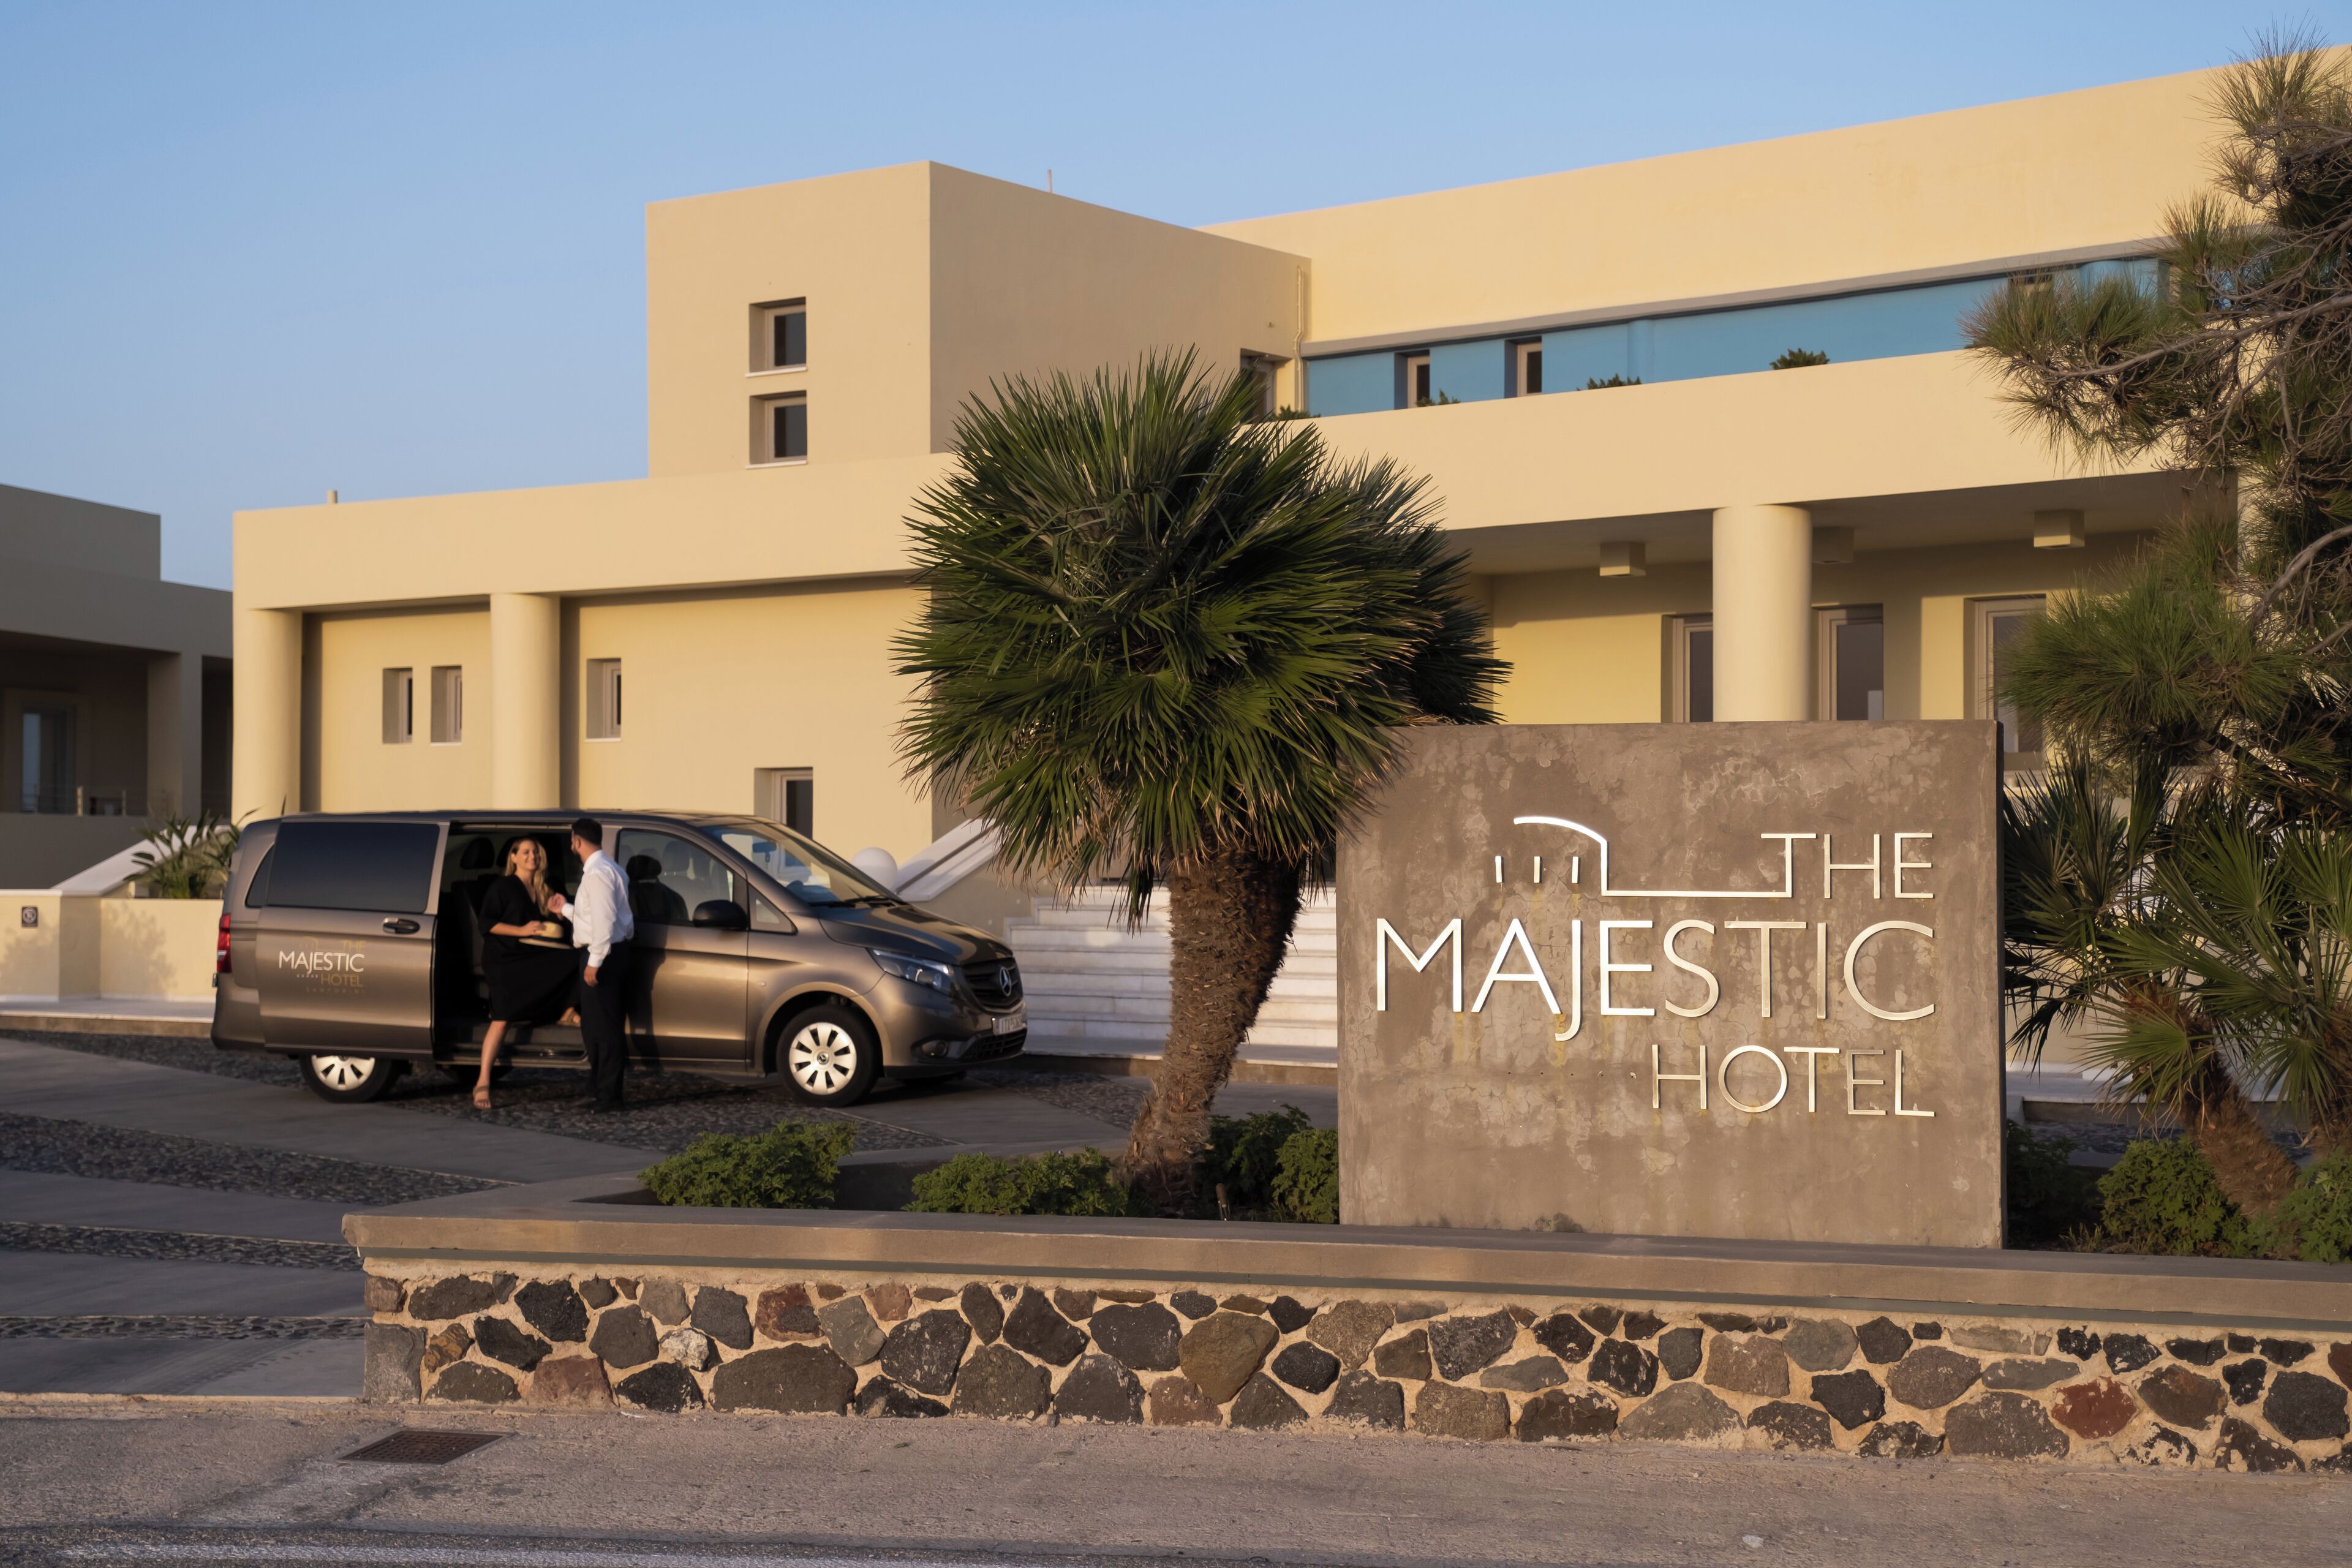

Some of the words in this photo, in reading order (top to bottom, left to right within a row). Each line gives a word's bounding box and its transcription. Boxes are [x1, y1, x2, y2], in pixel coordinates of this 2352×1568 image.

[1761, 833, 1934, 899] THE
[279, 950, 365, 974] MAJESTIC
[342, 940, 367, 952] THE
[321, 973, 363, 987] HOTEL
[1376, 918, 1934, 1041] MAJESTIC
[1651, 1044, 1936, 1117] HOTEL
